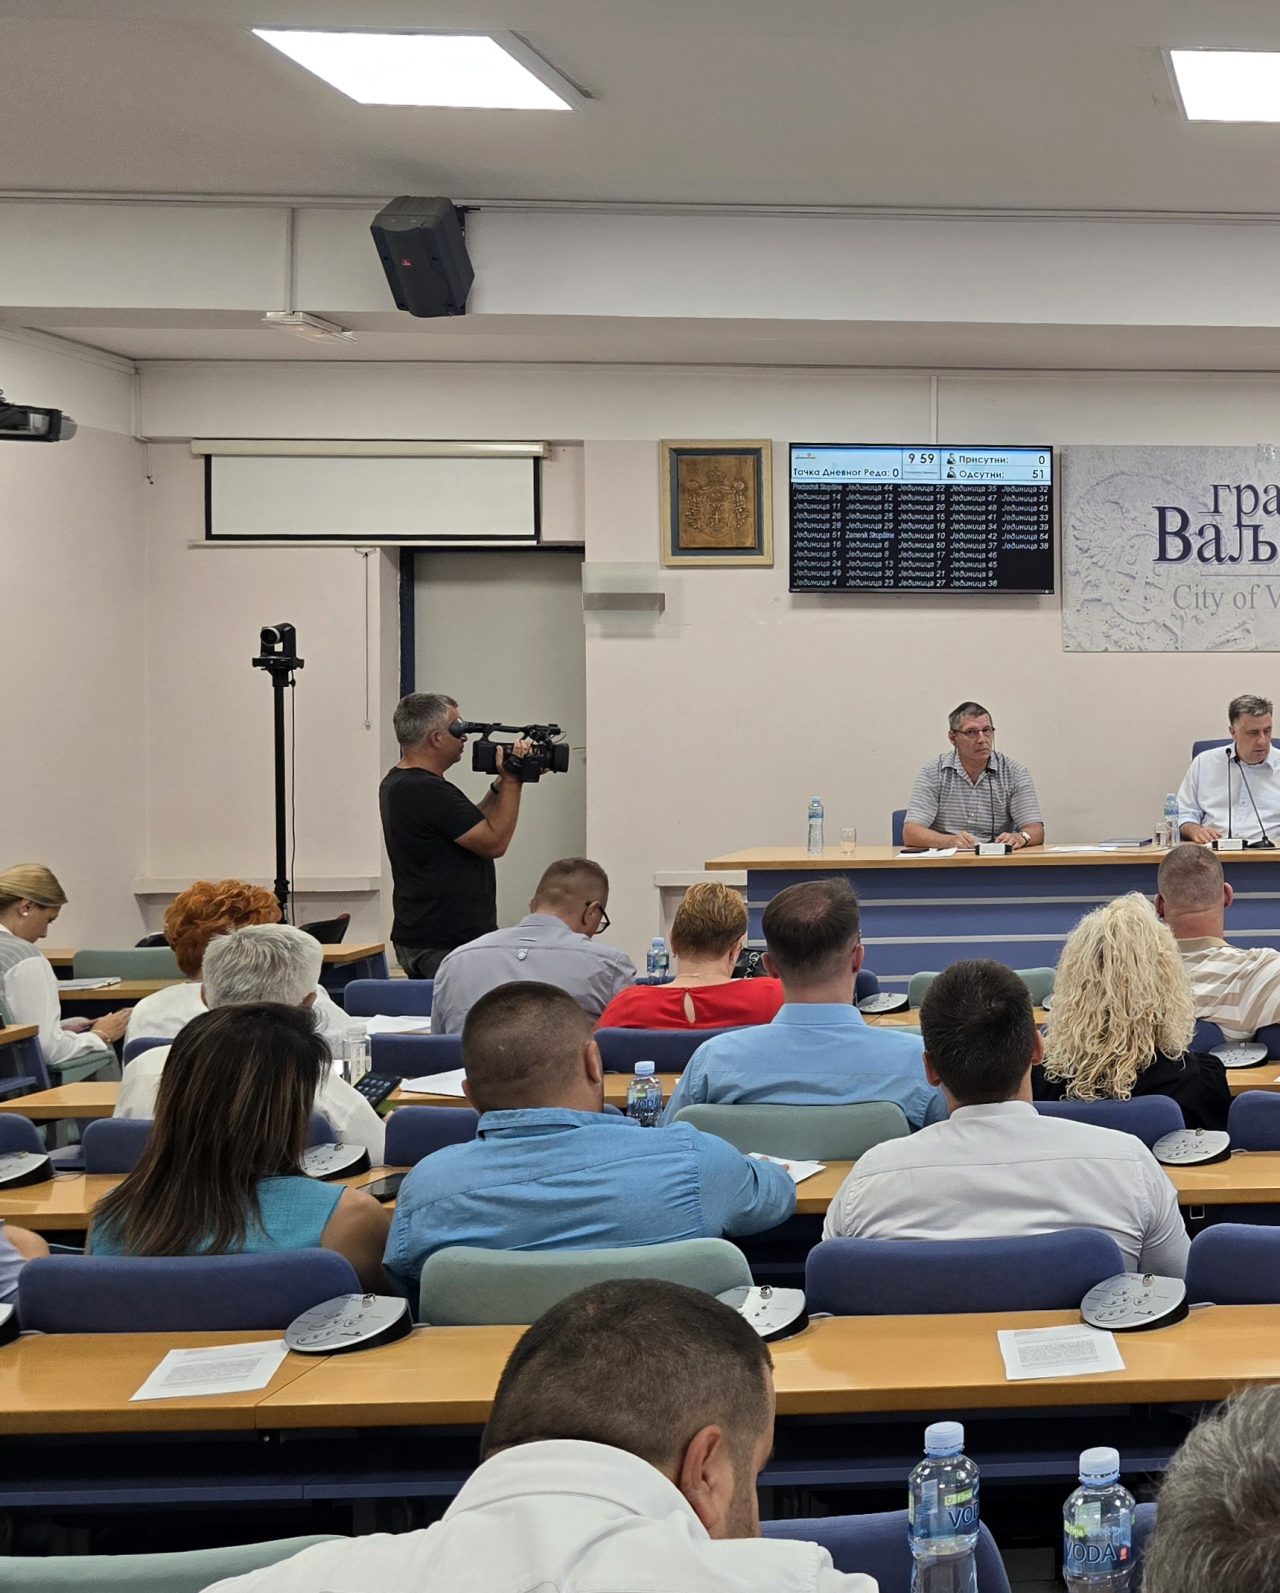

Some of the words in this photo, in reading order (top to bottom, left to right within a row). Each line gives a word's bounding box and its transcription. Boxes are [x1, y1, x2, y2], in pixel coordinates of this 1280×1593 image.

[908, 453, 915, 463] 9
[920, 453, 935, 464] 59
[959, 455, 1009, 465] Присутни:
[1038, 455, 1046, 465] 0
[794, 468, 820, 476] Тачка
[822, 468, 861, 477] Дневног
[864, 468, 890, 477] Реда:
[892, 468, 900, 477] 0
[959, 470, 1005, 479] Одсутни:
[1032, 469, 1044, 479] 51
[1173, 583, 1224, 616] City
[1233, 583, 1260, 610] of
